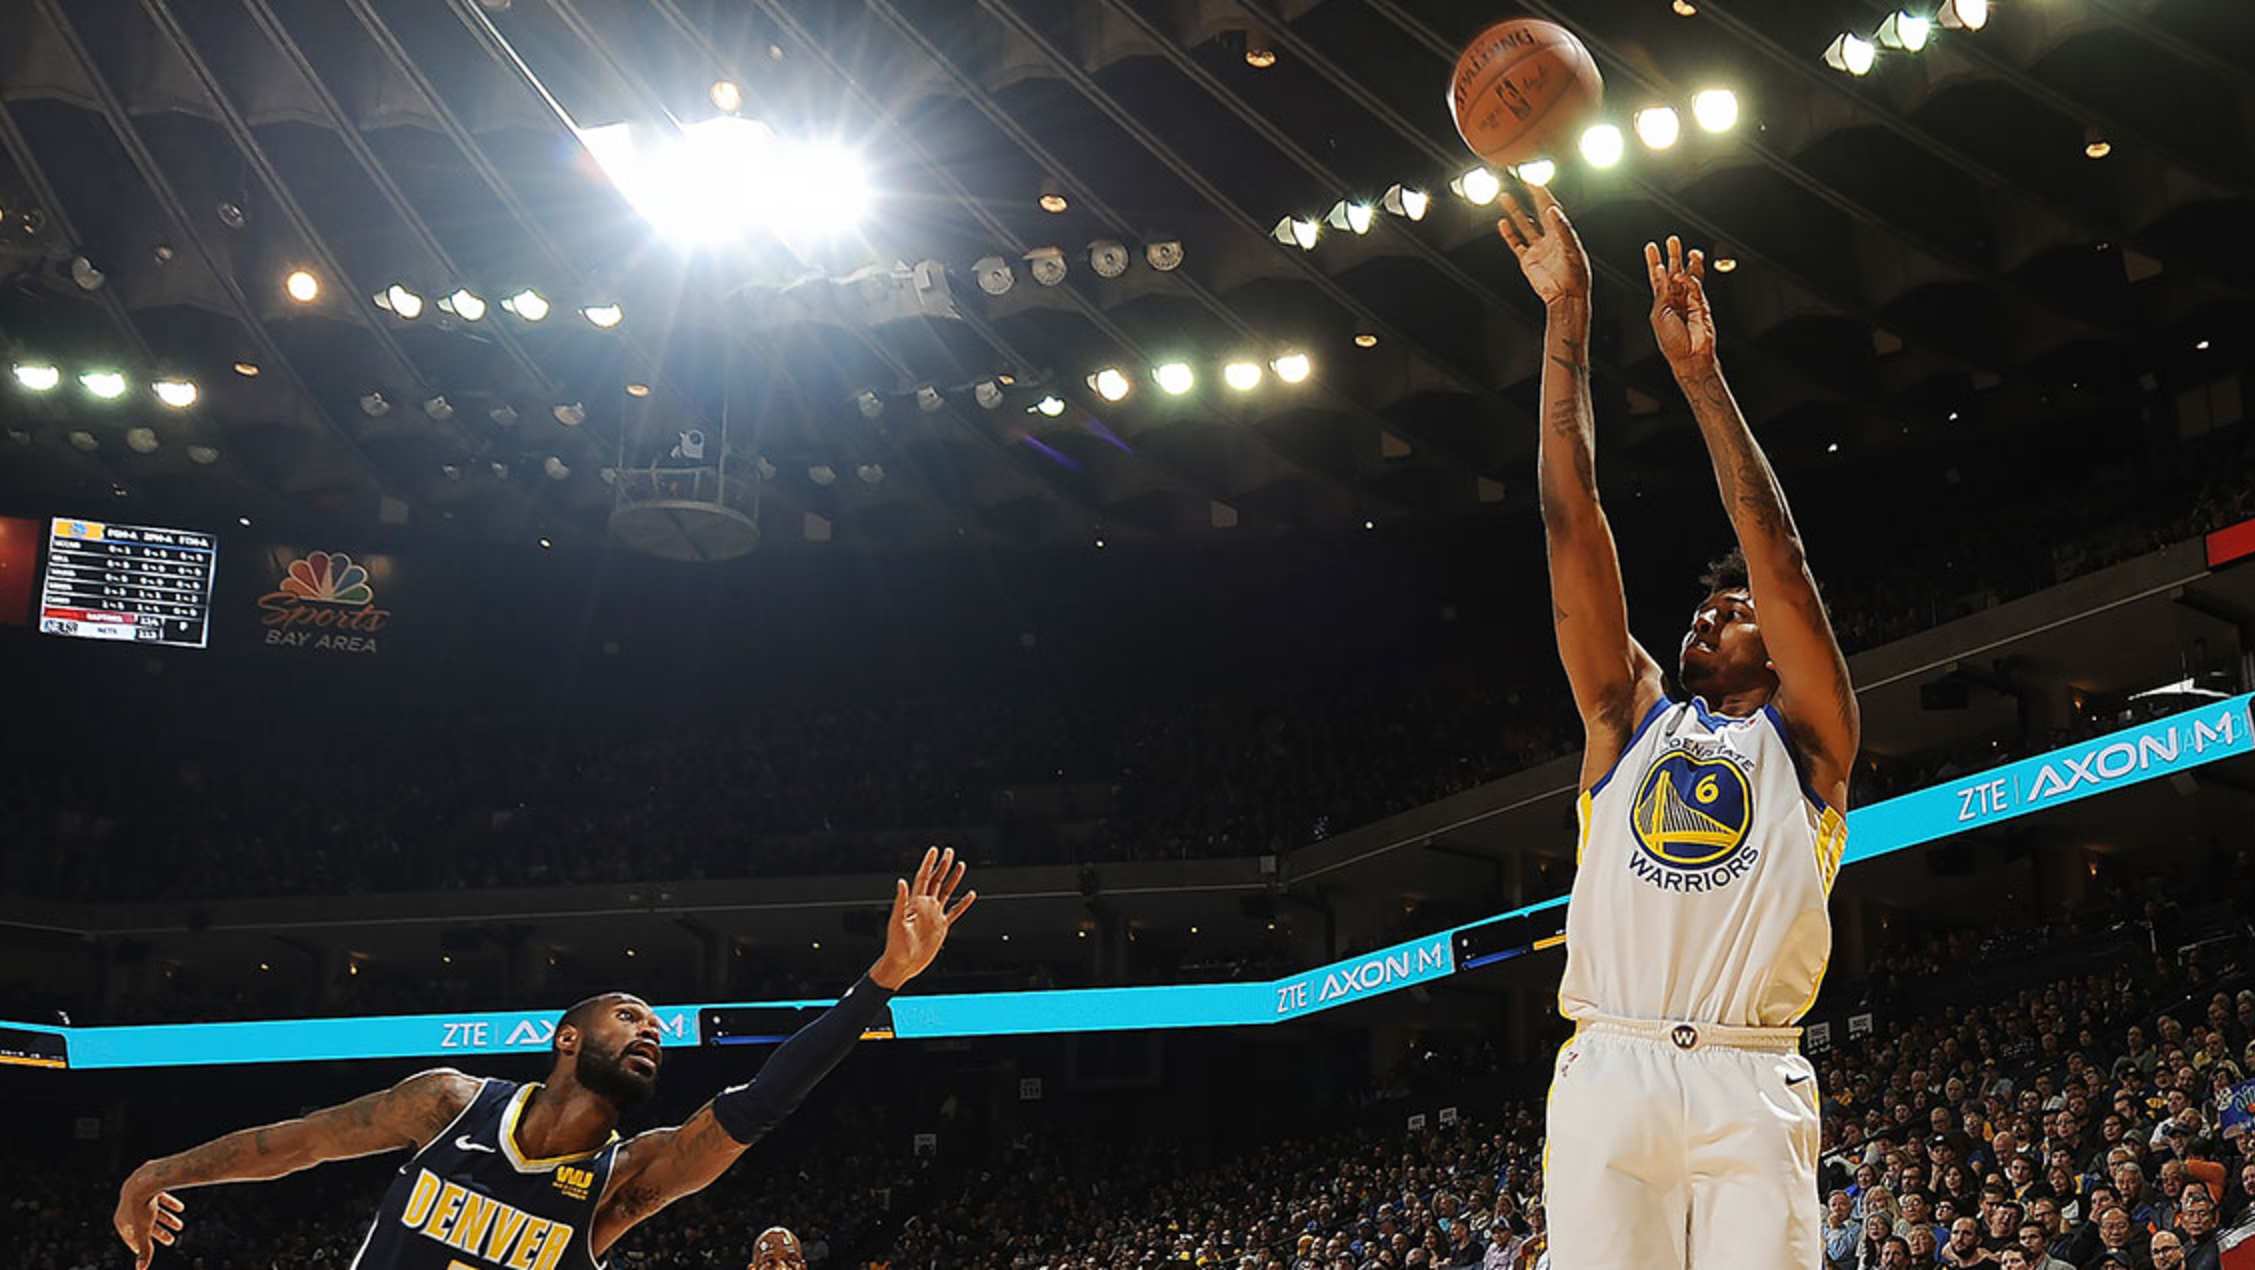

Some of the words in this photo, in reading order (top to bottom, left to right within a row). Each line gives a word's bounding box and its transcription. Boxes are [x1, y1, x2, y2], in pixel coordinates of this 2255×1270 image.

[257, 591, 391, 632] Sports
[265, 629, 312, 646] BAY
[315, 634, 377, 653] AREA
[1957, 779, 2008, 822] ZTE
[2027, 726, 2178, 802] AXON
[2194, 711, 2234, 753] M
[1695, 774, 1720, 804] 6
[1628, 845, 1760, 892] WARRIORS
[1276, 981, 1308, 1014] ZTE
[1318, 951, 1409, 1002] AXON
[1418, 942, 1442, 973] M
[441, 1022, 489, 1047] ZTE
[1675, 1030, 1696, 1047] W
[401, 1167, 575, 1270] DENVER
